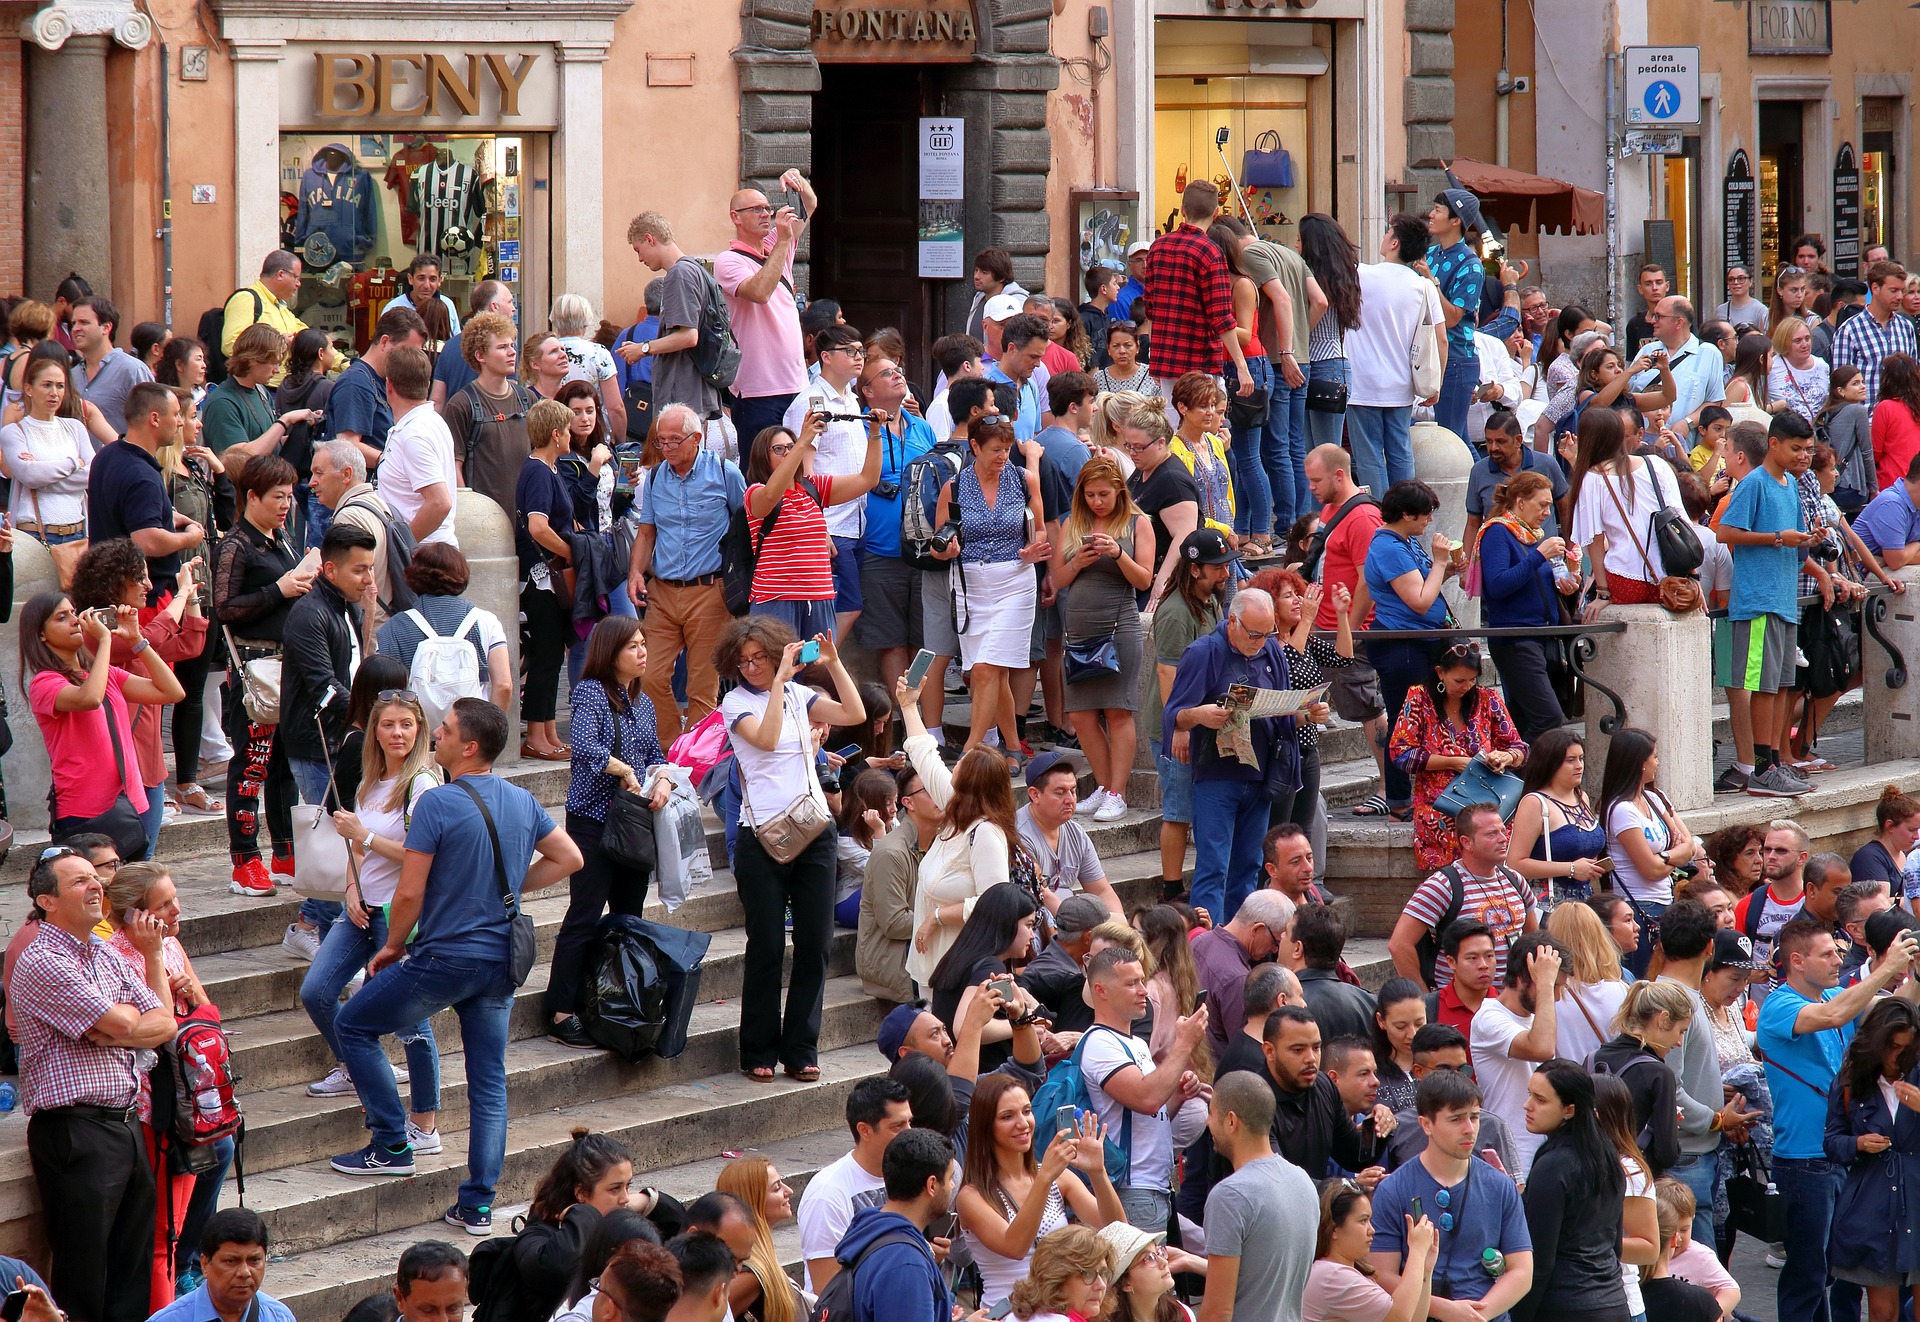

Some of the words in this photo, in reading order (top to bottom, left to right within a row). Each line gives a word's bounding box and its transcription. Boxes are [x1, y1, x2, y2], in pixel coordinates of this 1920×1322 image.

[816, 8, 976, 41] FONTANA
[1760, 6, 1816, 40] FORNO
[185, 49, 206, 73] 95
[1650, 54, 1674, 62] area
[1638, 64, 1687, 75] pedonale
[313, 52, 540, 116] BENY
[933, 137, 951, 147] HF
[425, 194, 459, 211] Jeep
[369, 285, 394, 298] TOTTI
[323, 314, 342, 322] TOTTI
[1770, 913, 1792, 922] DISNEY
